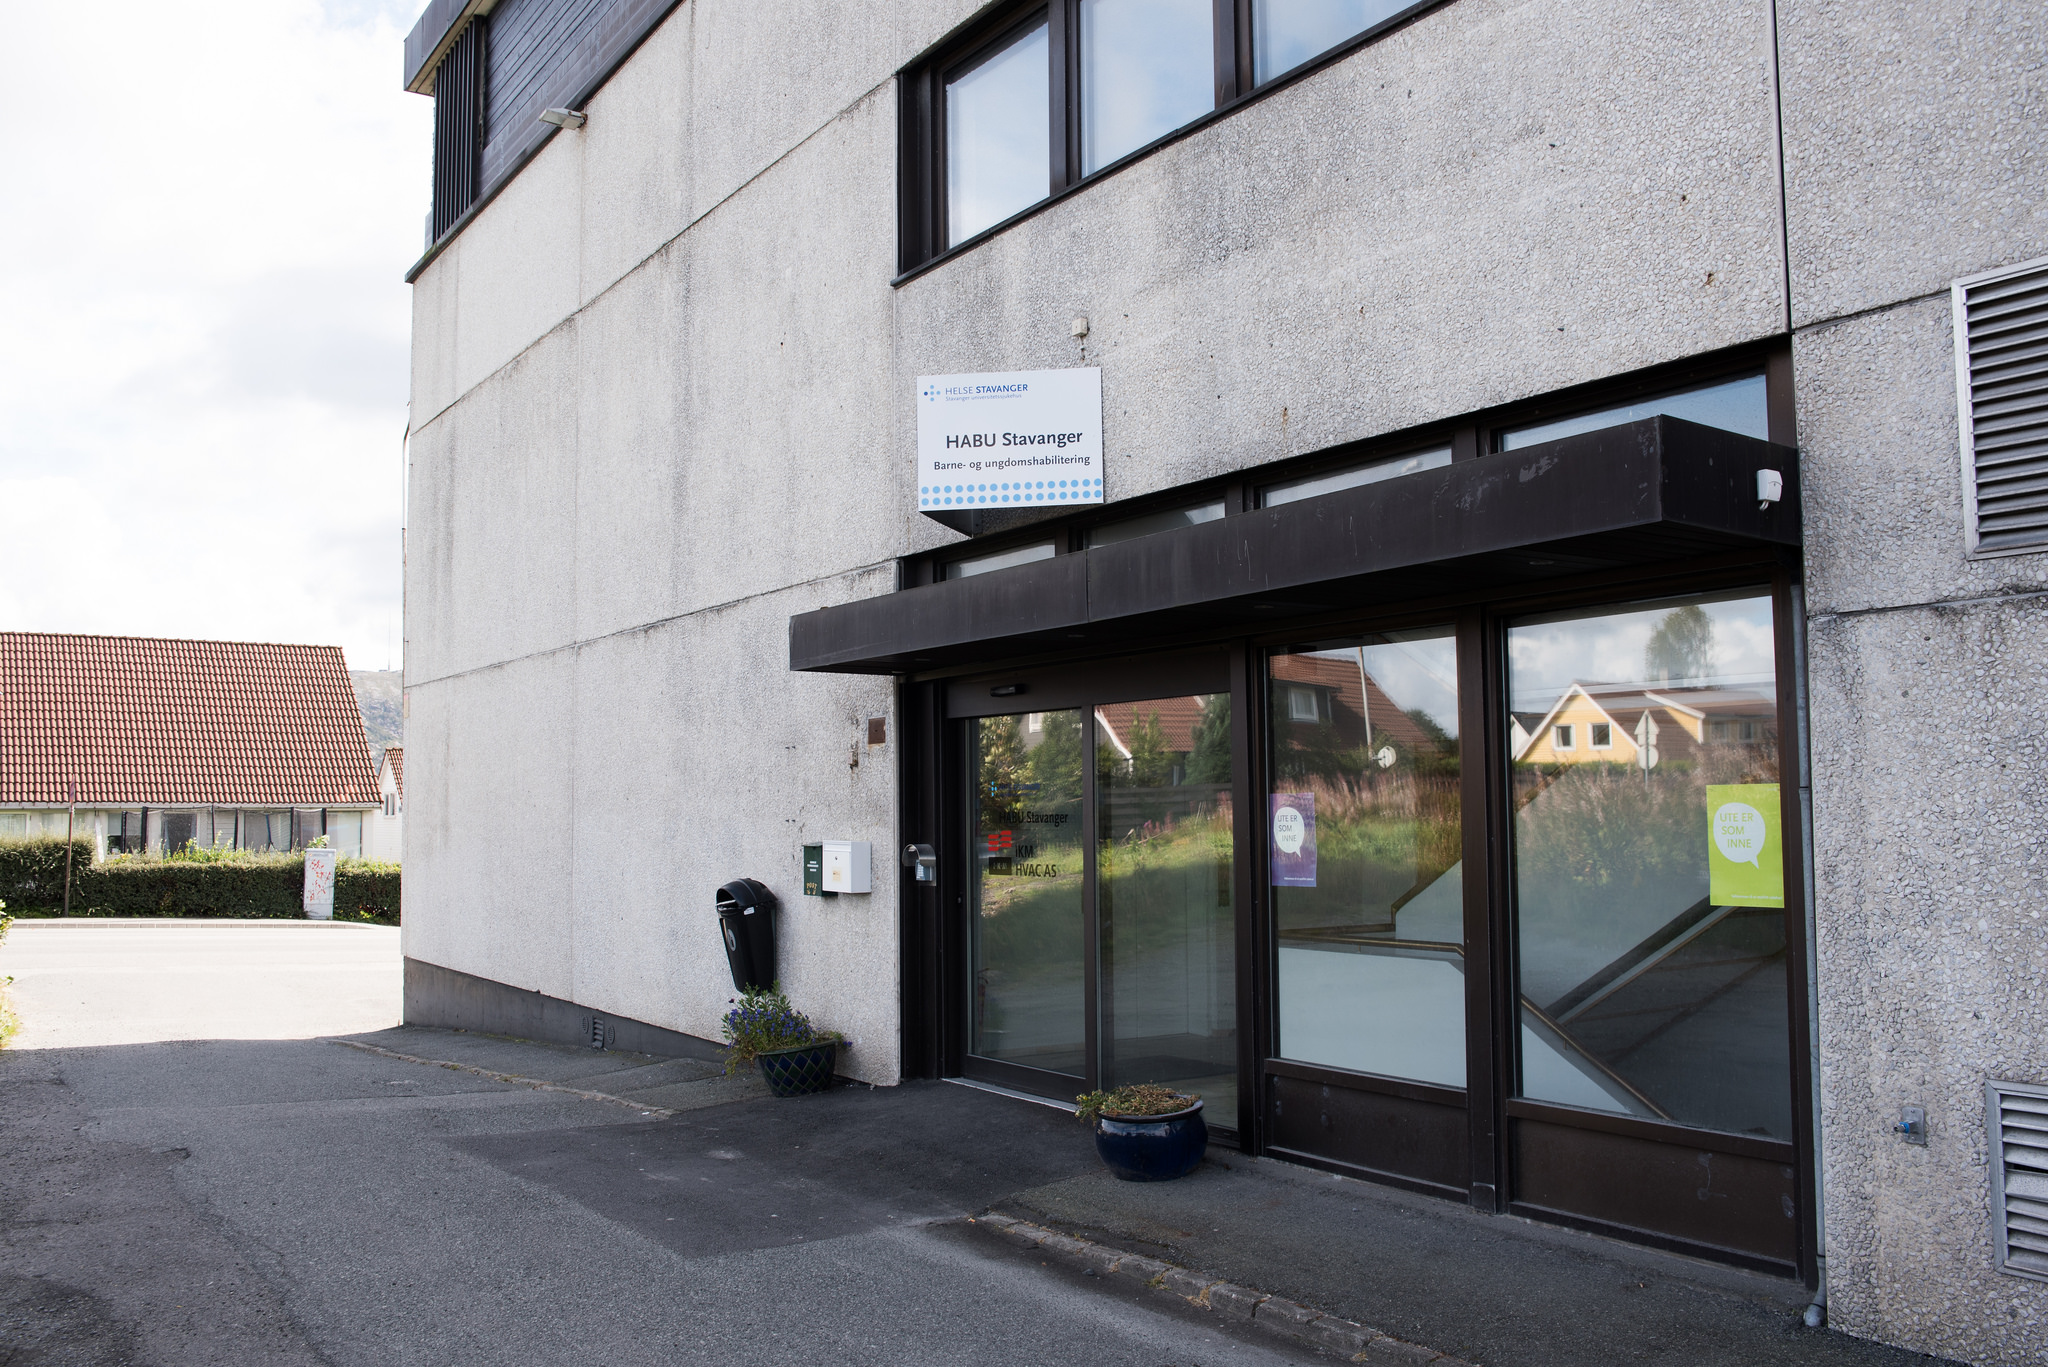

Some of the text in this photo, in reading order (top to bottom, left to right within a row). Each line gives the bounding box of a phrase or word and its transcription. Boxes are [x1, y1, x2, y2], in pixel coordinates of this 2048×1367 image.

[945, 384, 1028, 395] HELSE STAVANGER
[946, 431, 1082, 449] HABU Stavanger
[934, 454, 1091, 471] Barne- og ungdomshabilitering
[1026, 811, 1068, 827] Stavanger
[1720, 813, 1753, 822] UTE ER
[1721, 826, 1745, 835] SOM
[1727, 839, 1752, 848] INNE
[1015, 845, 1034, 858] IKM
[1015, 864, 1042, 877] HVAC
[1044, 864, 1057, 878] AS
